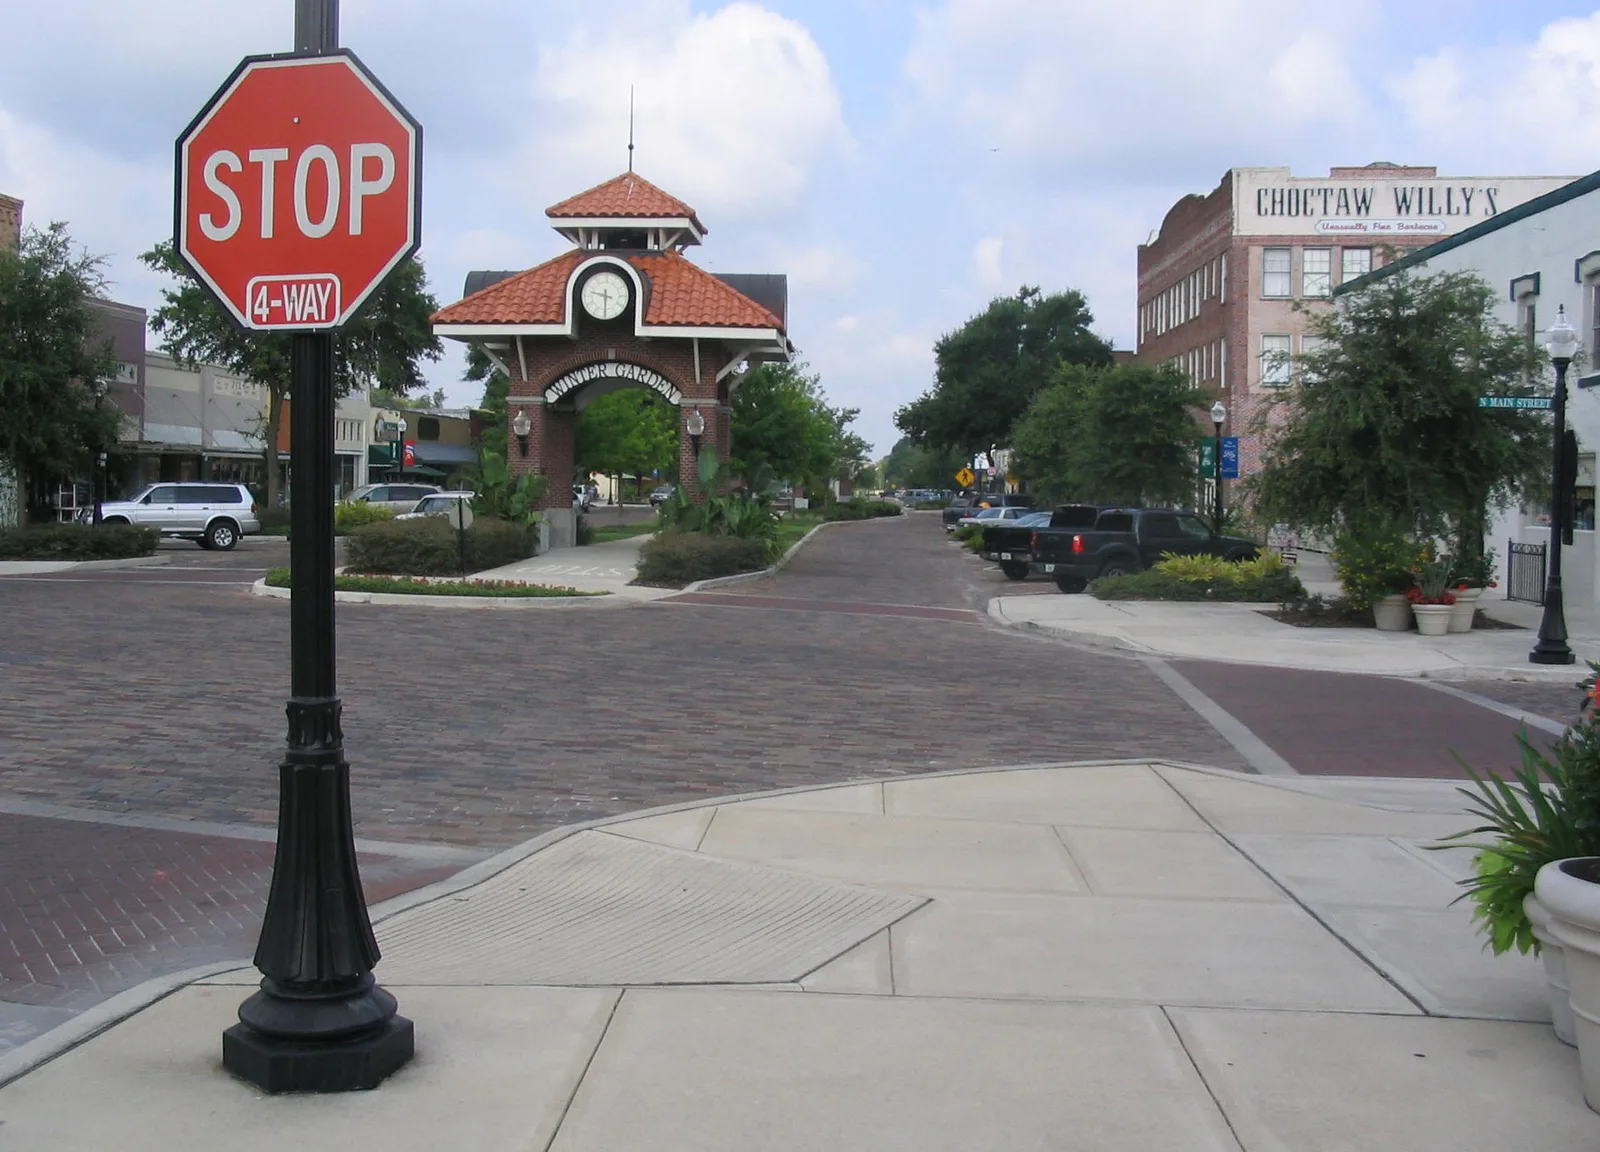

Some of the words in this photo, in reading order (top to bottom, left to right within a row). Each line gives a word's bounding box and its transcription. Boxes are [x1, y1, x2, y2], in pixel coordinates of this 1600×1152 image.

[199, 142, 396, 242] STOP
[1256, 187, 1375, 217] CHOCTAW
[1393, 186, 1500, 217] WILLY'S
[1396, 222, 1439, 230] Barbecue
[253, 282, 332, 322] 4-WAY
[549, 363, 607, 397] WINTER
[615, 363, 680, 402] GARDEN
[1479, 397, 1488, 407] N
[1490, 397, 1513, 408] MAIN
[1516, 398, 1552, 409] STREET
